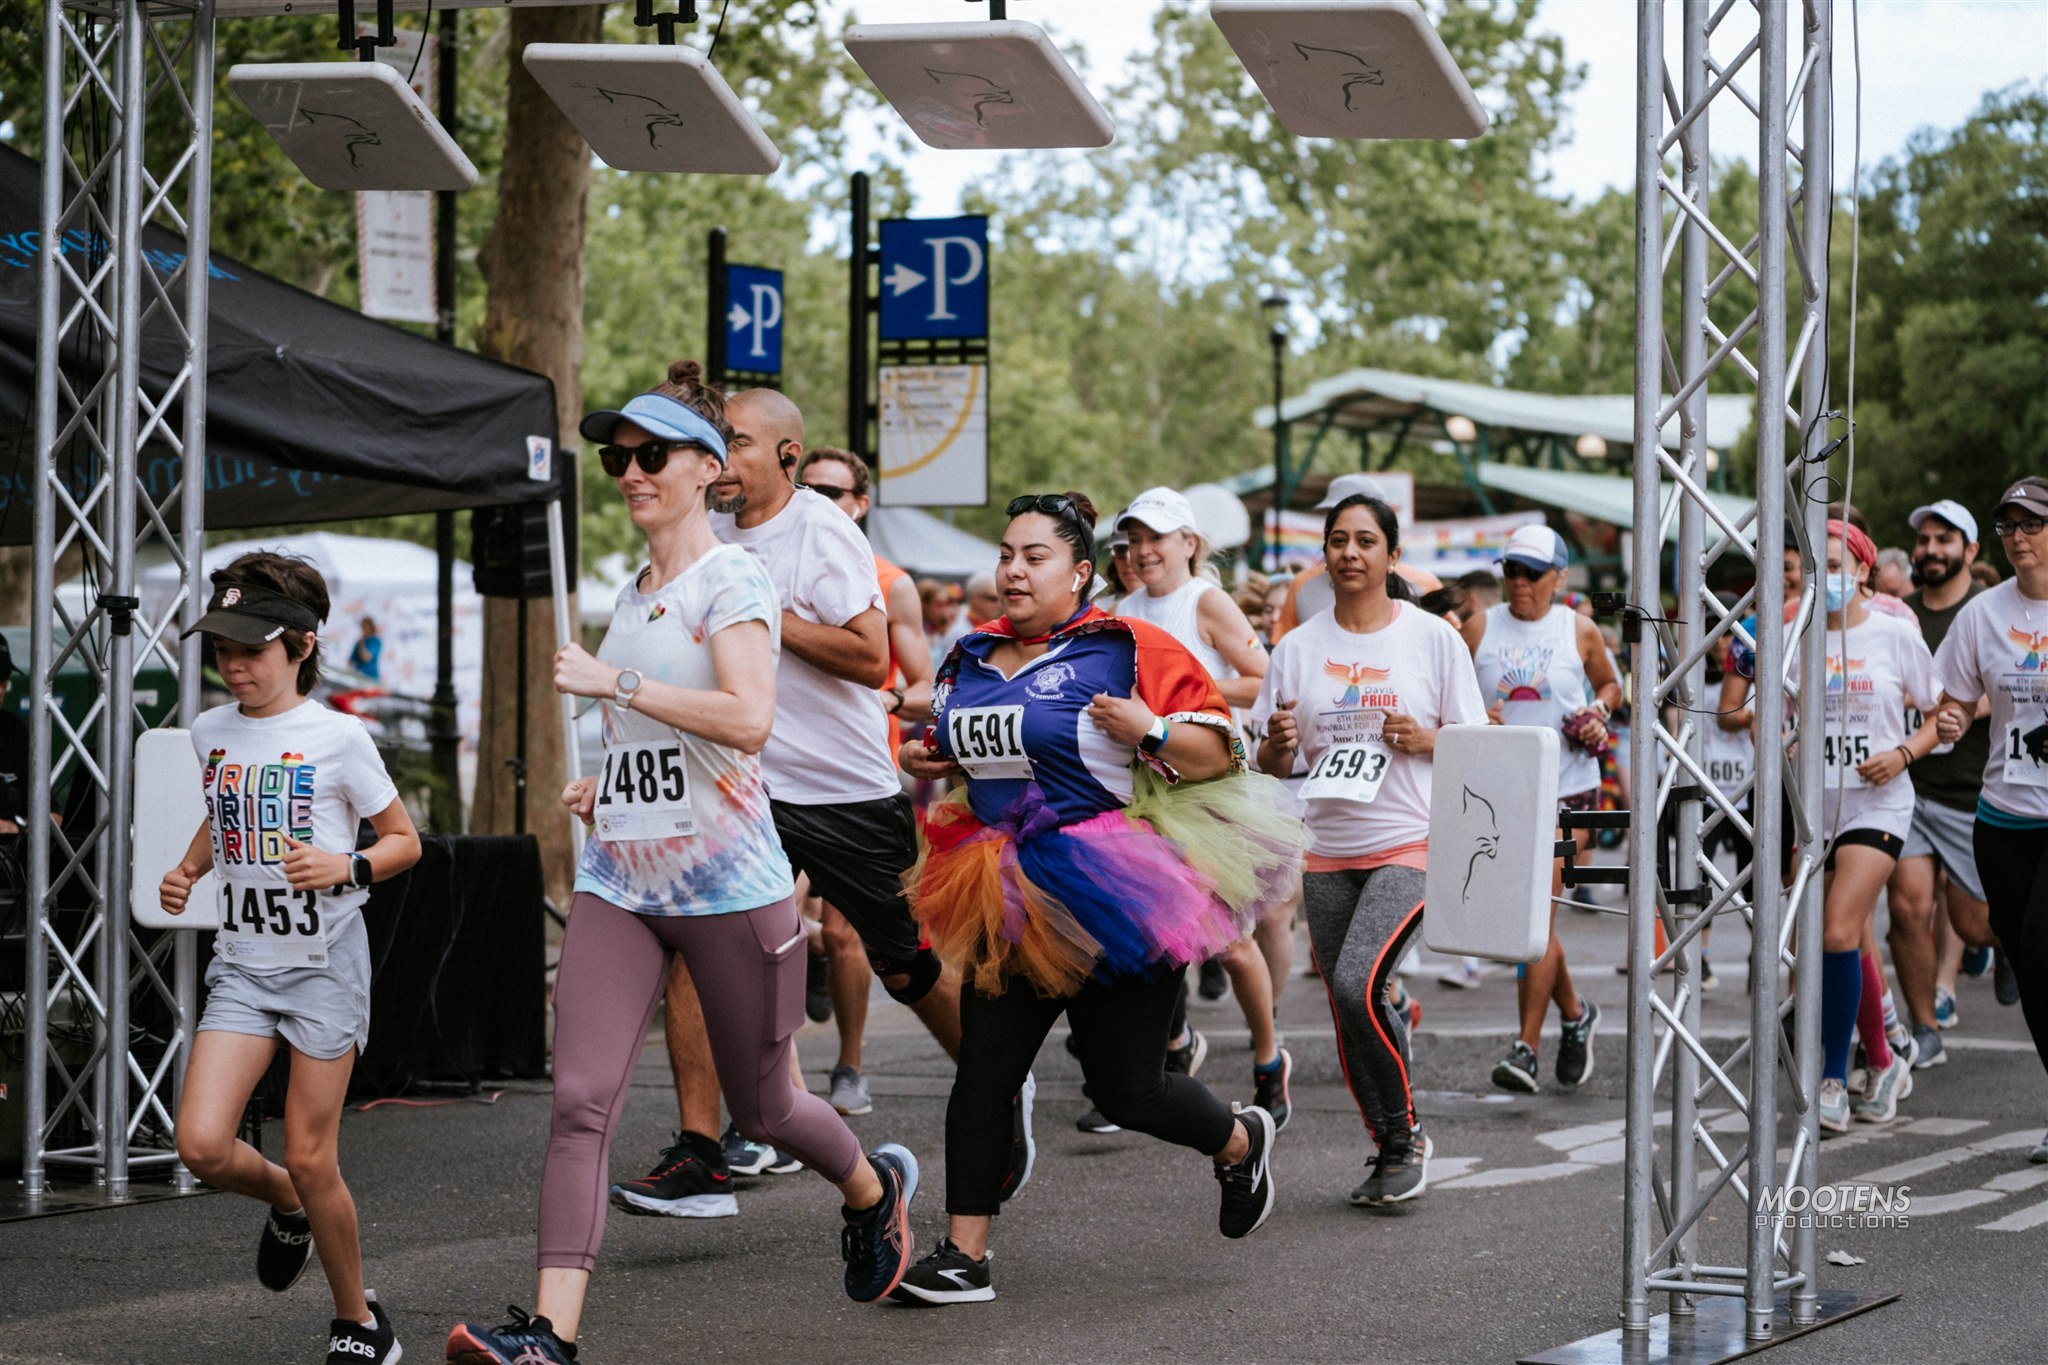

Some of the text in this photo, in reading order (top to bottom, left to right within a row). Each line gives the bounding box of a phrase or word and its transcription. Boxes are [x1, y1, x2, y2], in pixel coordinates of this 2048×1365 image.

[924, 236, 984, 320] P
[751, 284, 782, 356] P
[1361, 694, 1398, 707] PRIDE
[1365, 686, 1394, 694] Davis
[952, 712, 1022, 759] 1591
[1332, 734, 1354, 743] June
[599, 747, 685, 805] 1485
[1310, 749, 1387, 782] 1593
[222, 882, 320, 936] 1453
